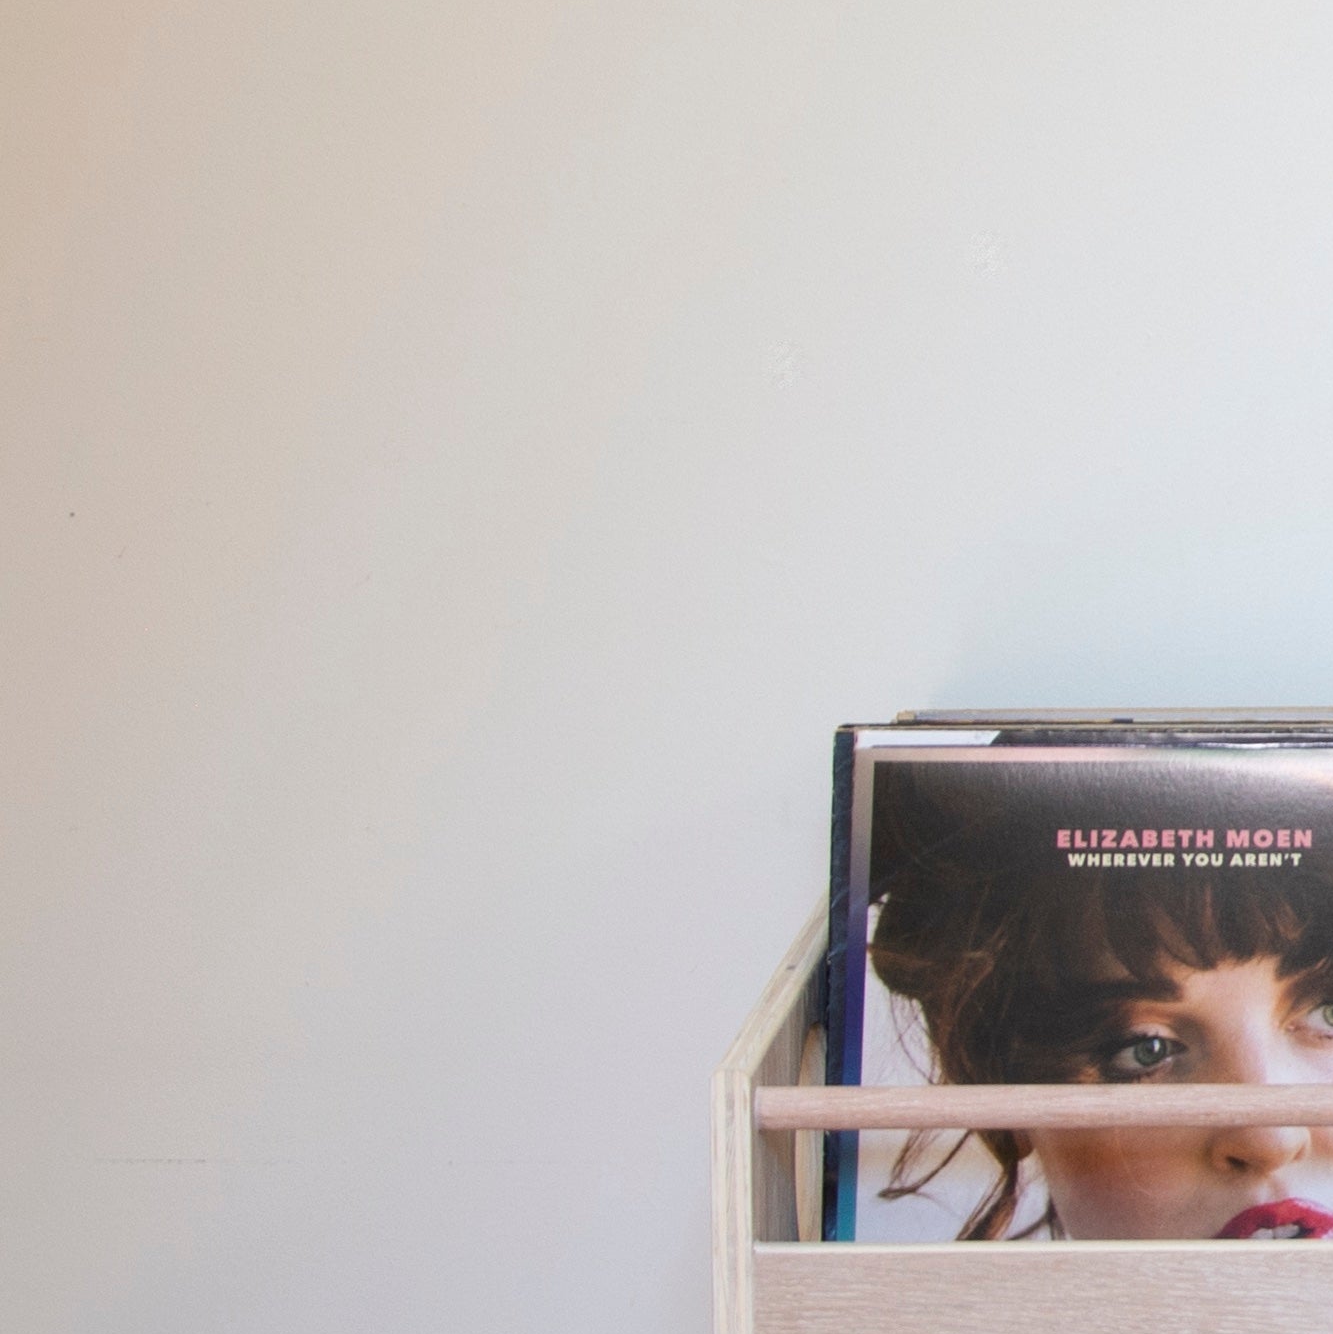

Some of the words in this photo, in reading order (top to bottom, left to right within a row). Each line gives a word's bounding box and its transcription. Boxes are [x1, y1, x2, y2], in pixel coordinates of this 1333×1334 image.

[1056, 829, 1215, 850] ELIZABETH
[1226, 829, 1312, 849] MOEN
[1067, 852, 1177, 868] WHEREVER
[1182, 852, 1225, 868] YOU
[1229, 852, 1303, 868] AREN'T
